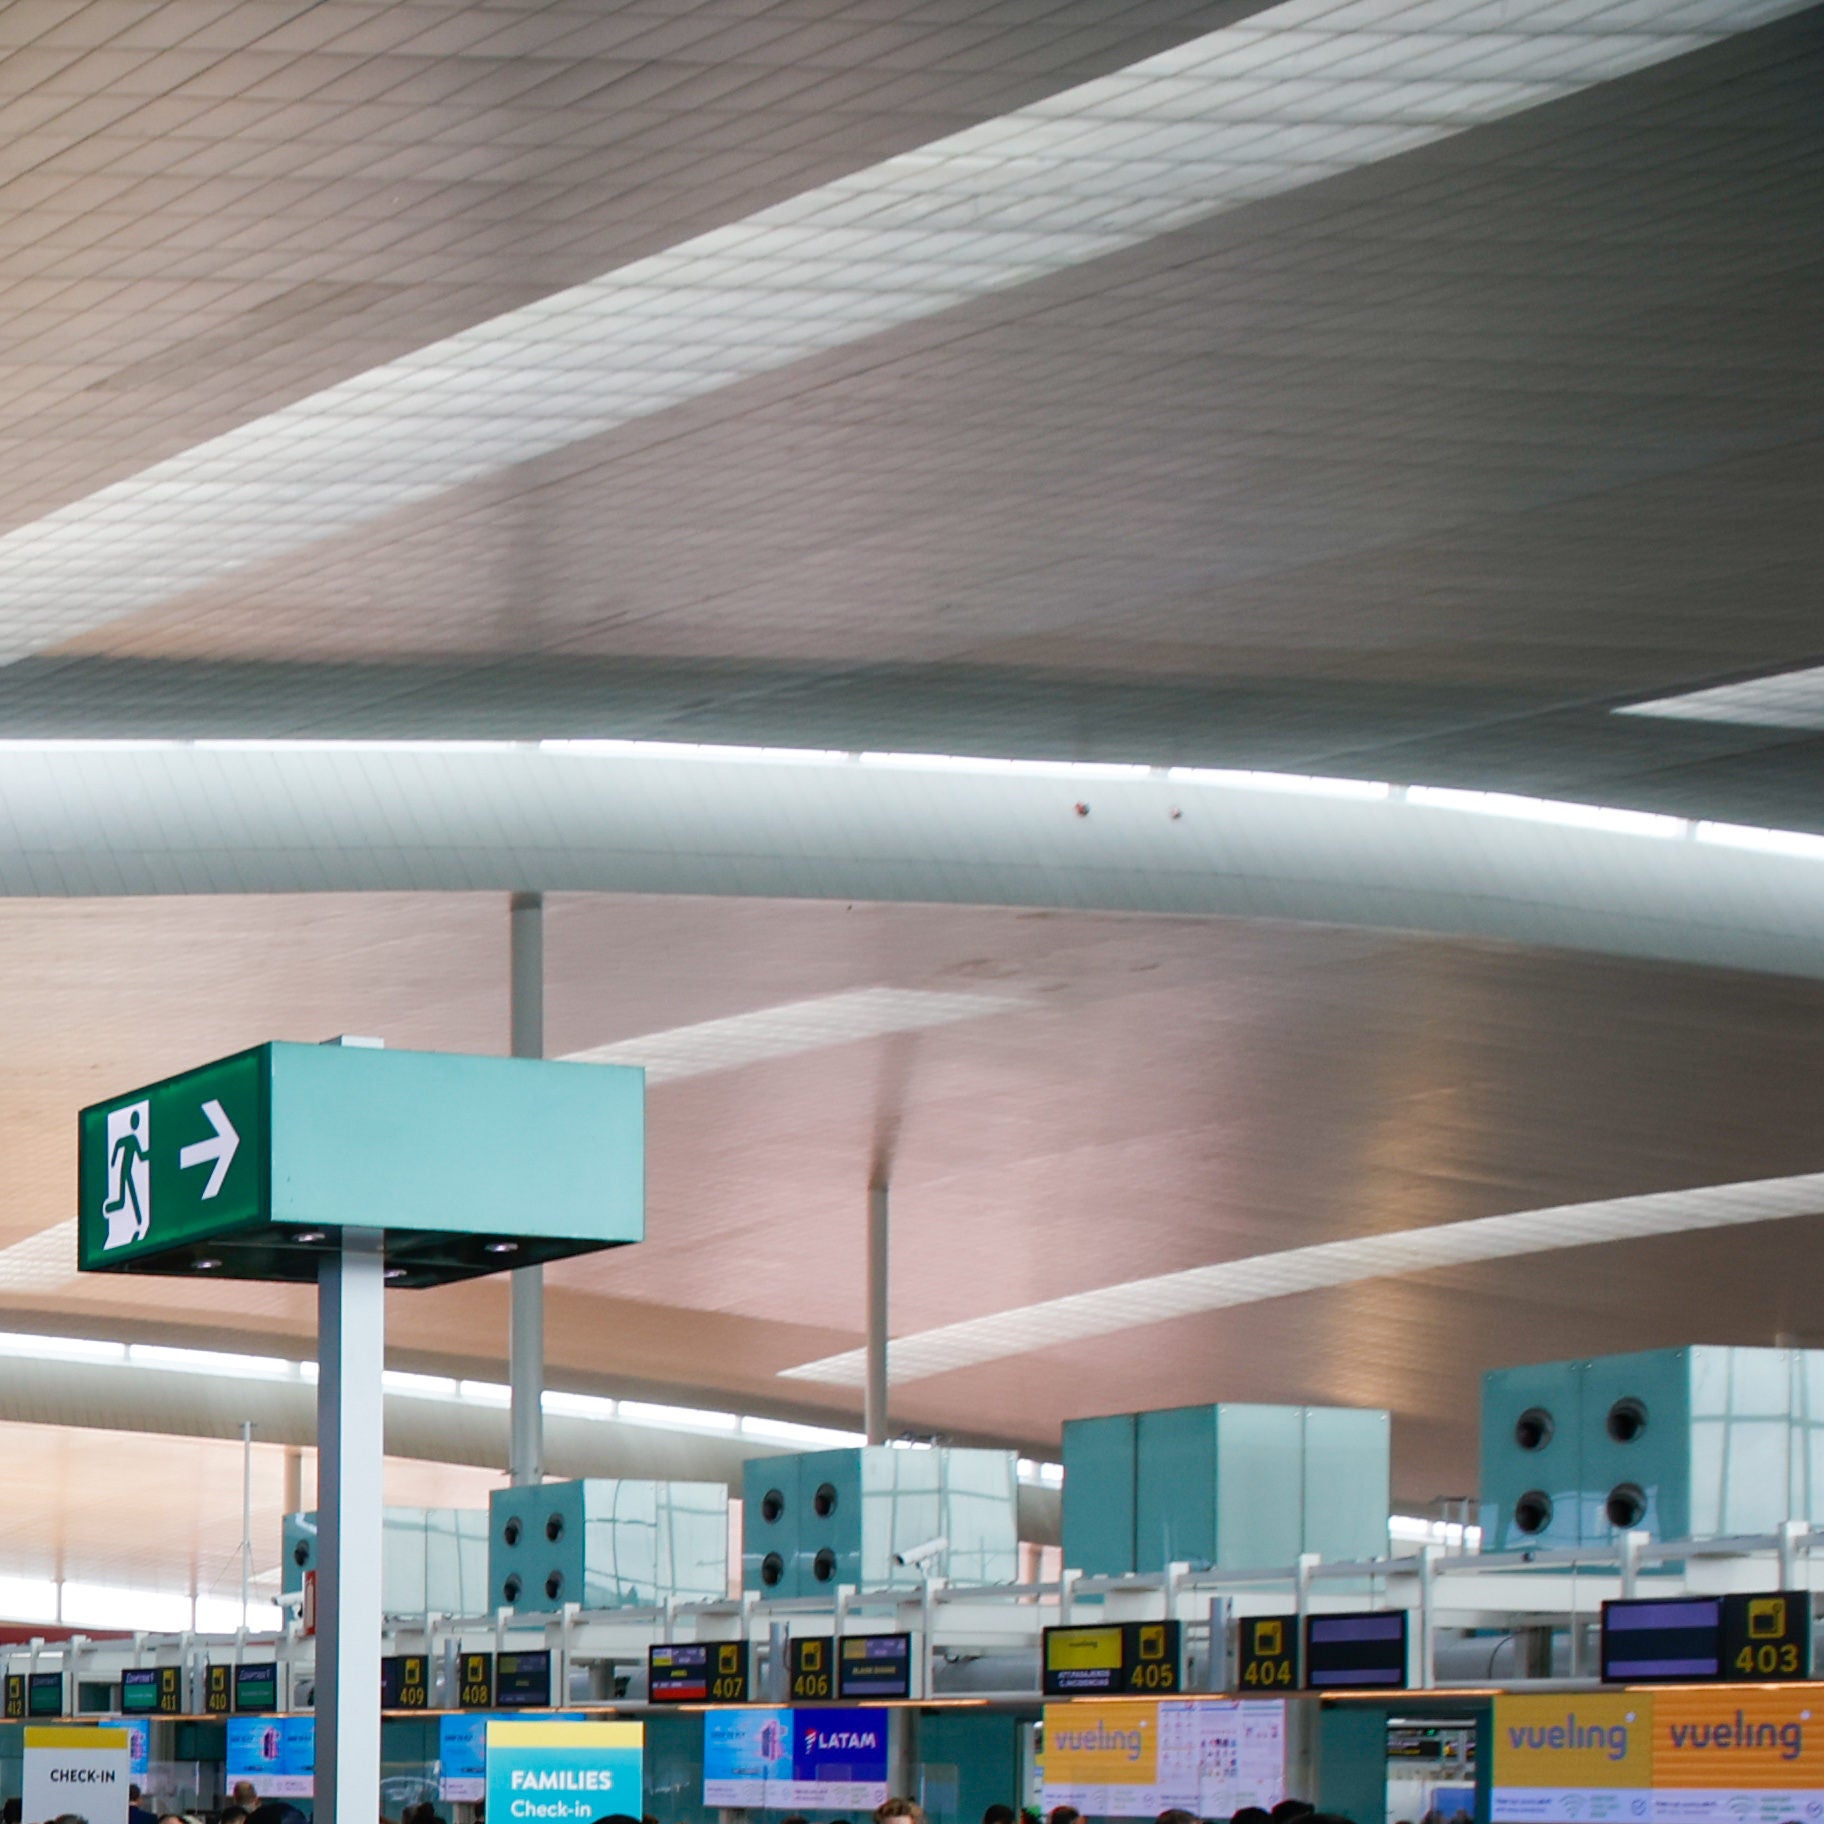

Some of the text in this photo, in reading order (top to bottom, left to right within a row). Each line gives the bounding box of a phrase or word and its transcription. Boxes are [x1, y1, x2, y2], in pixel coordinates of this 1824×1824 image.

[1735, 1643, 1799, 1674] 403
[1130, 1663, 1174, 1688] 405
[1244, 1660, 1292, 1685] 404
[400, 1686, 425, 1705] 409
[462, 1685, 489, 1705] 408
[712, 1676, 744, 1698] 407
[794, 1674, 828, 1697] 406
[160, 1694, 177, 1711] 411
[209, 1692, 227, 1710] 410
[818, 1731, 877, 1750] LATAM
[1055, 1719, 1142, 1761] vueling
[1508, 1713, 1629, 1761] vueling
[1670, 1709, 1803, 1761] vueling
[50, 1768, 116, 1784] CHECK-IN
[510, 1770, 613, 1791] FAMILIES
[510, 1799, 592, 1818] Check-in
